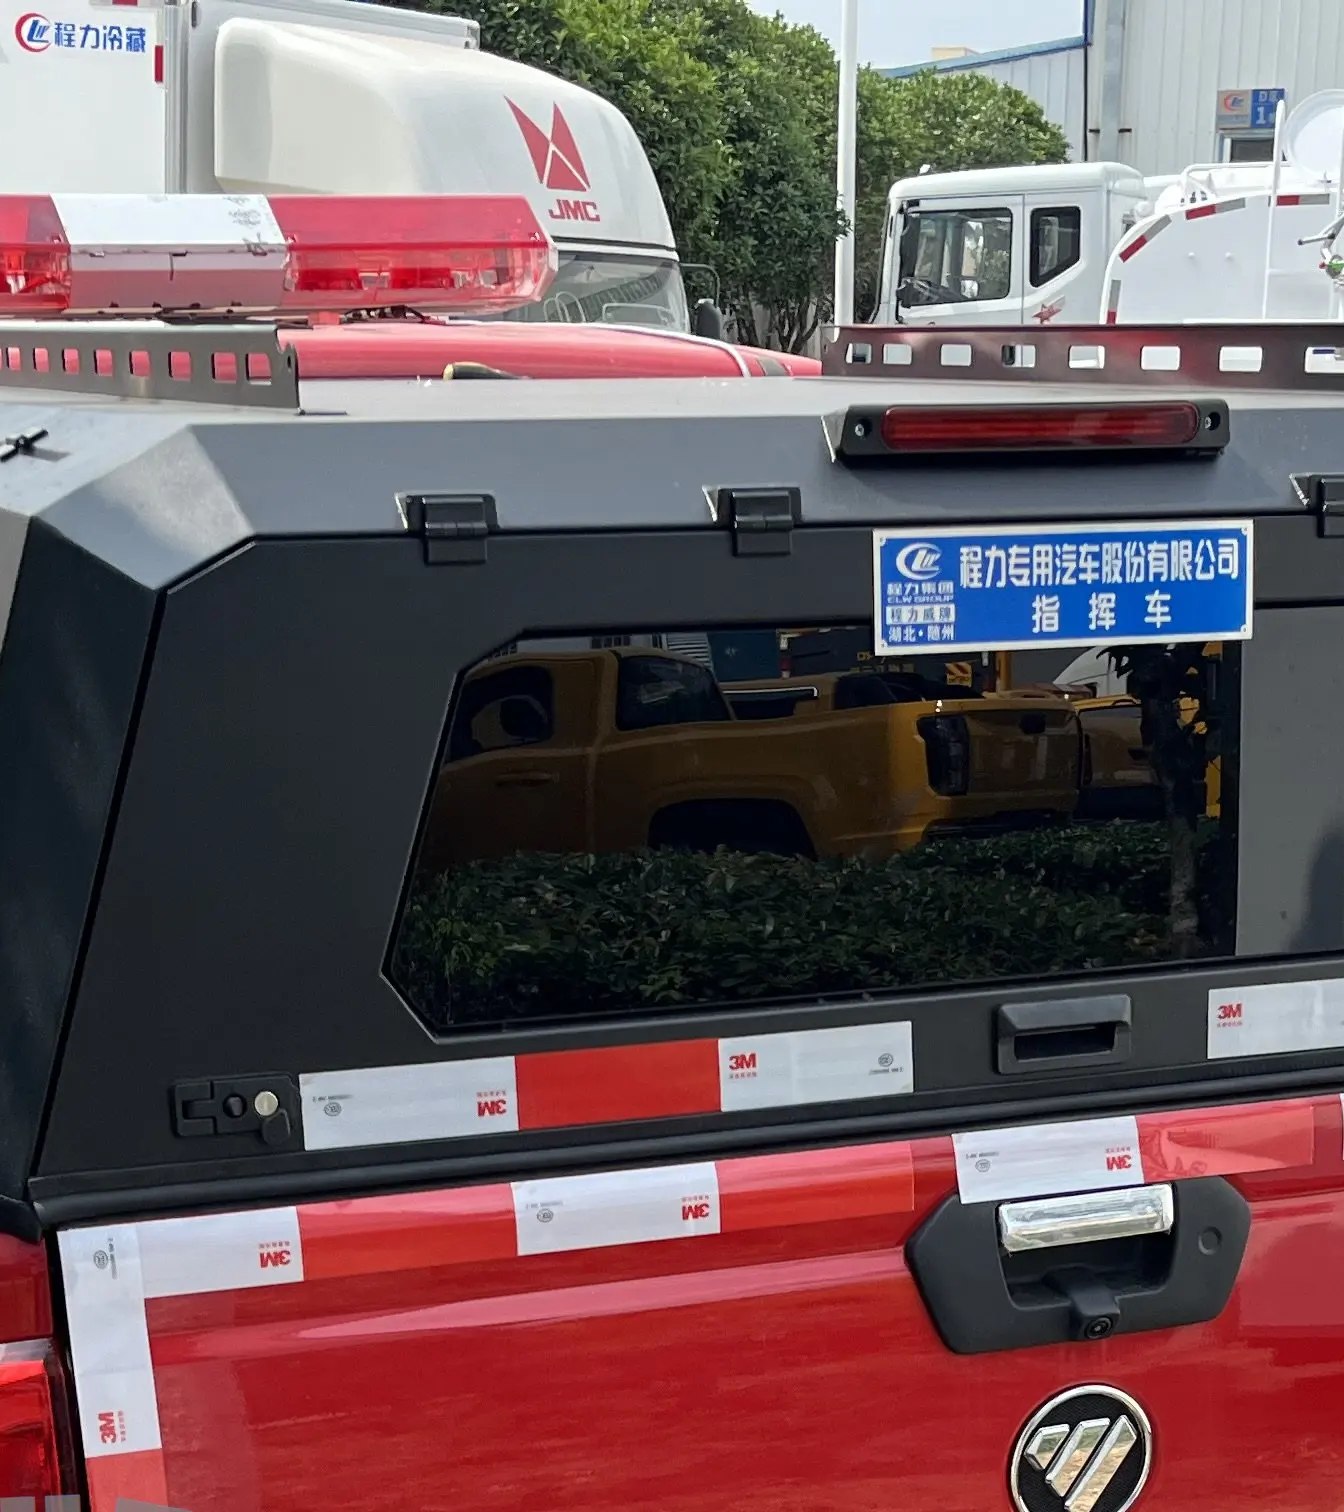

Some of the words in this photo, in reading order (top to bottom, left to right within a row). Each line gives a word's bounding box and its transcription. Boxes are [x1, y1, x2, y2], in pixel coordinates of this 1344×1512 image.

[54, 22, 146, 52] 程力冷藏
[548, 198, 600, 222] JMC
[960, 538, 1239, 588] 程力专用汽车股份有限公司
[1217, 1003, 1243, 1019] 3M
[729, 1053, 757, 1070] 3M
[477, 1099, 506, 1117] 3M
[1106, 1155, 1132, 1171] 3M
[682, 1203, 710, 1221] 3M
[259, 1250, 291, 1268] 3M
[98, 1411, 117, 1444] 3M
